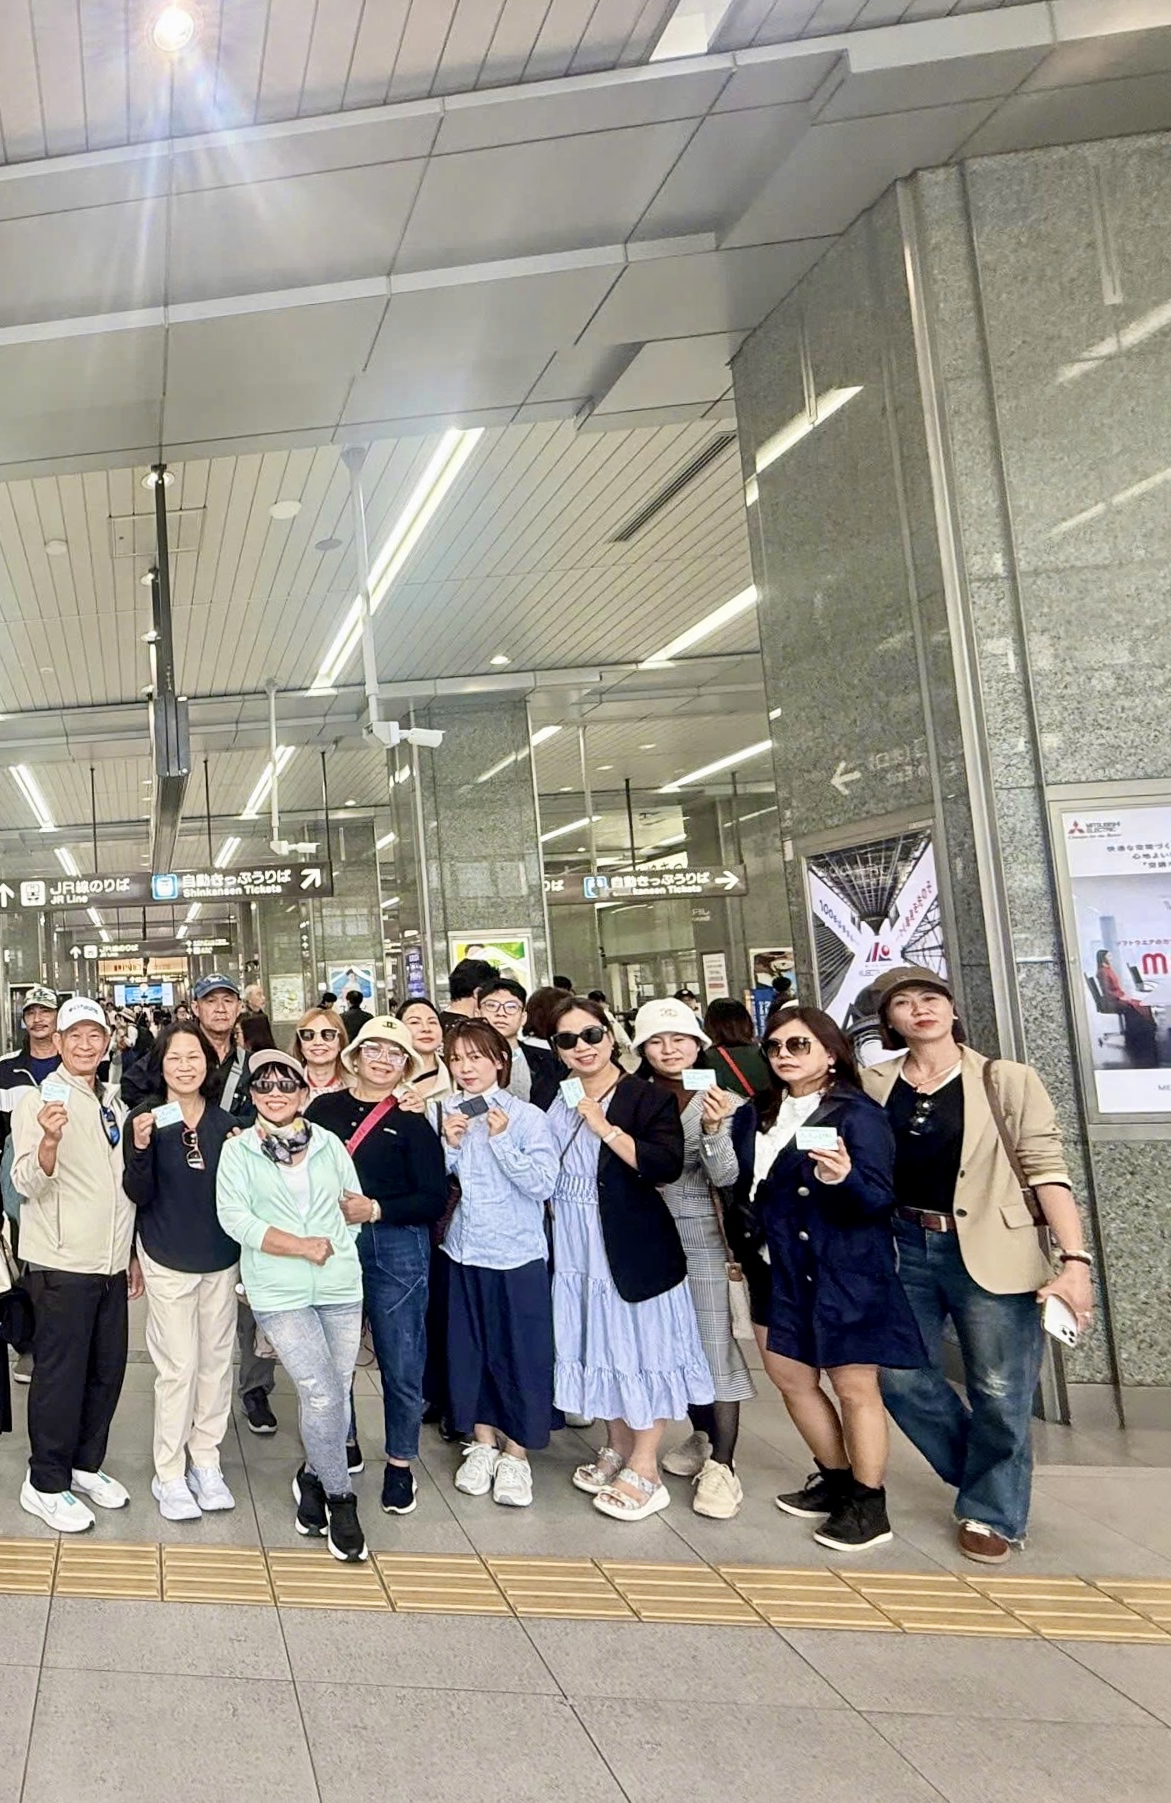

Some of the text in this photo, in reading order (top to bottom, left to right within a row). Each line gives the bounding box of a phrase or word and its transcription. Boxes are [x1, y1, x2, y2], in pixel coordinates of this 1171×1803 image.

[49, 877, 131, 895] JR線のりば
[182, 869, 291, 888] 自動きっぷうりば
[182, 884, 283, 898] Shinkansen Tickets
[50, 895, 88, 905] JR Line
